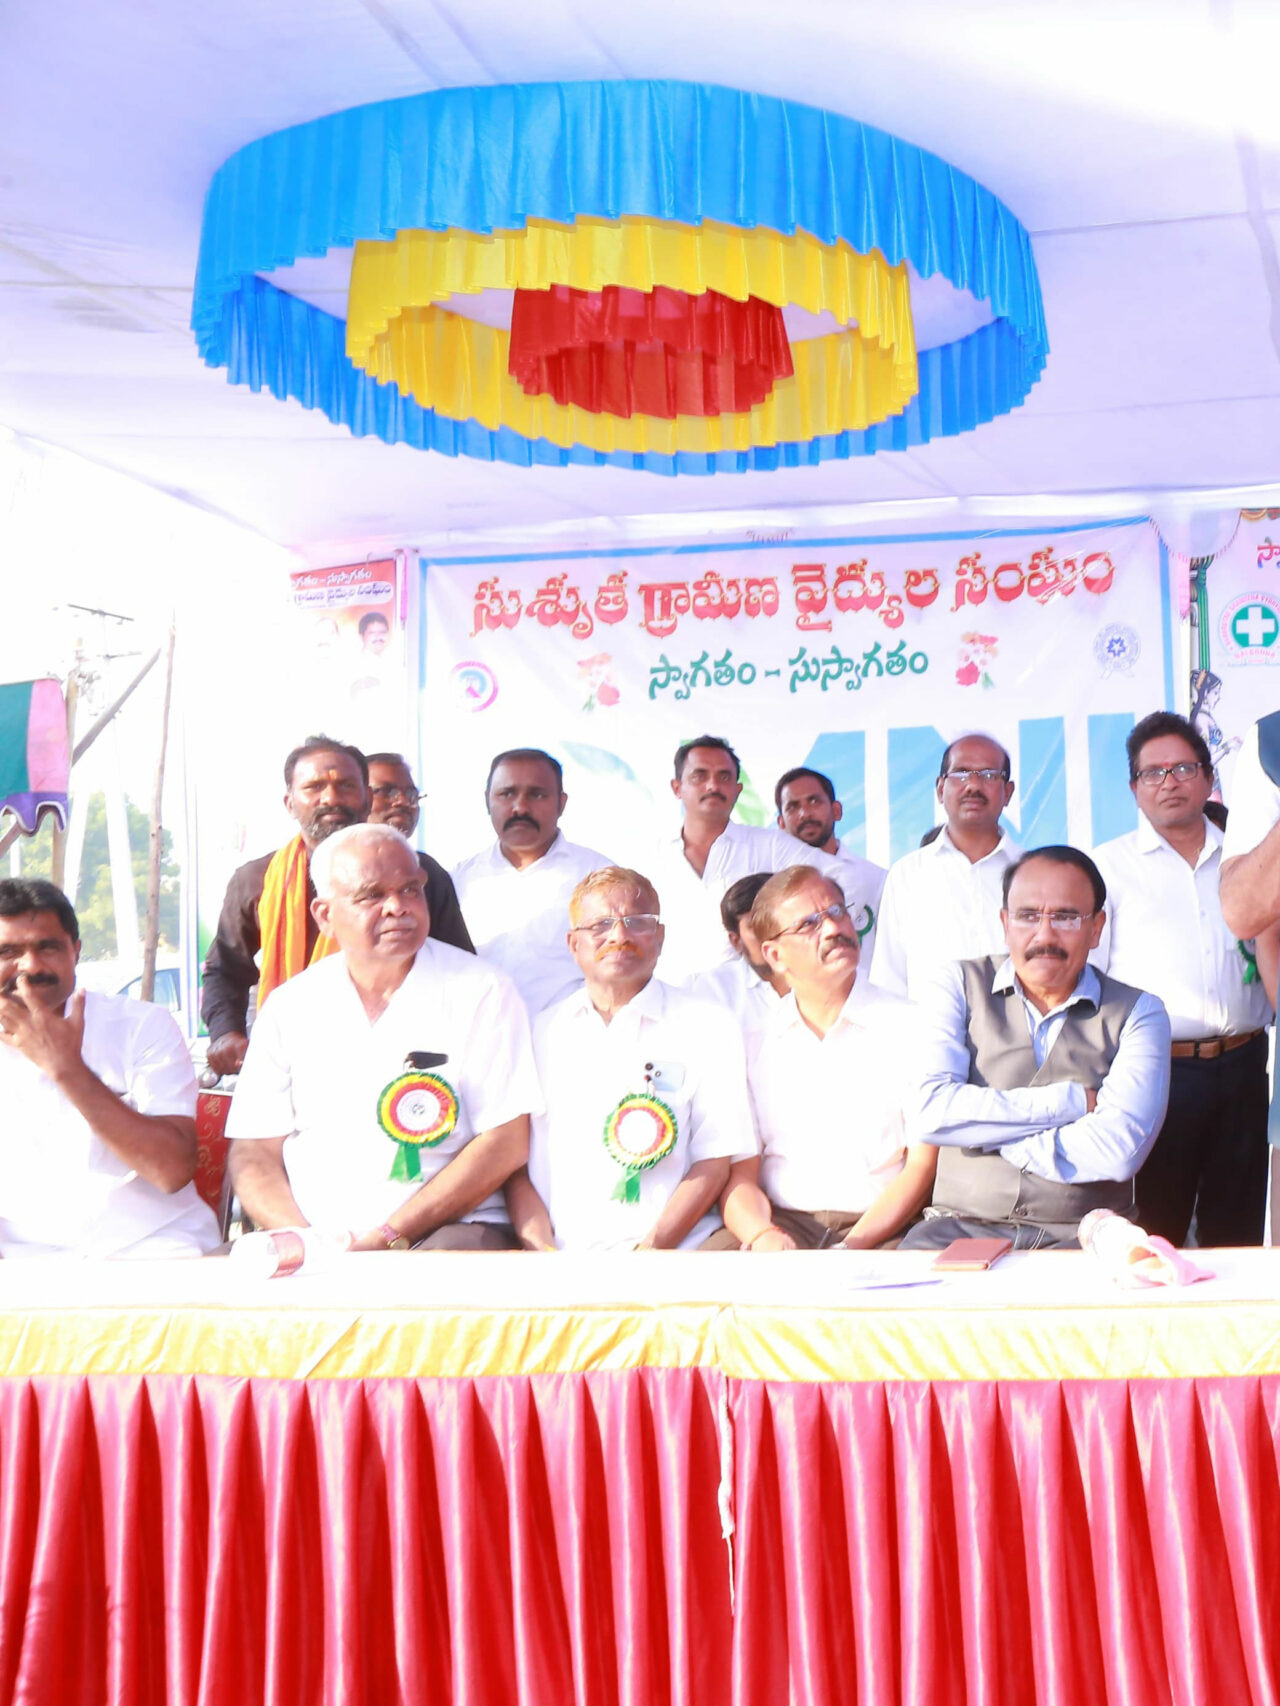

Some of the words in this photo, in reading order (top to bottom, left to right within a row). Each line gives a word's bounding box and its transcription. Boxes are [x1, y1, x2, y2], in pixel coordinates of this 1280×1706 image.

[637, 569, 780, 639] గ్రామీణ
[790, 557, 941, 633] వైద్యుల
[950, 546, 1116, 612] సంఘం
[648, 648, 757, 701] స్వాగతం
[787, 638, 930, 694] సుస్వాగతం
